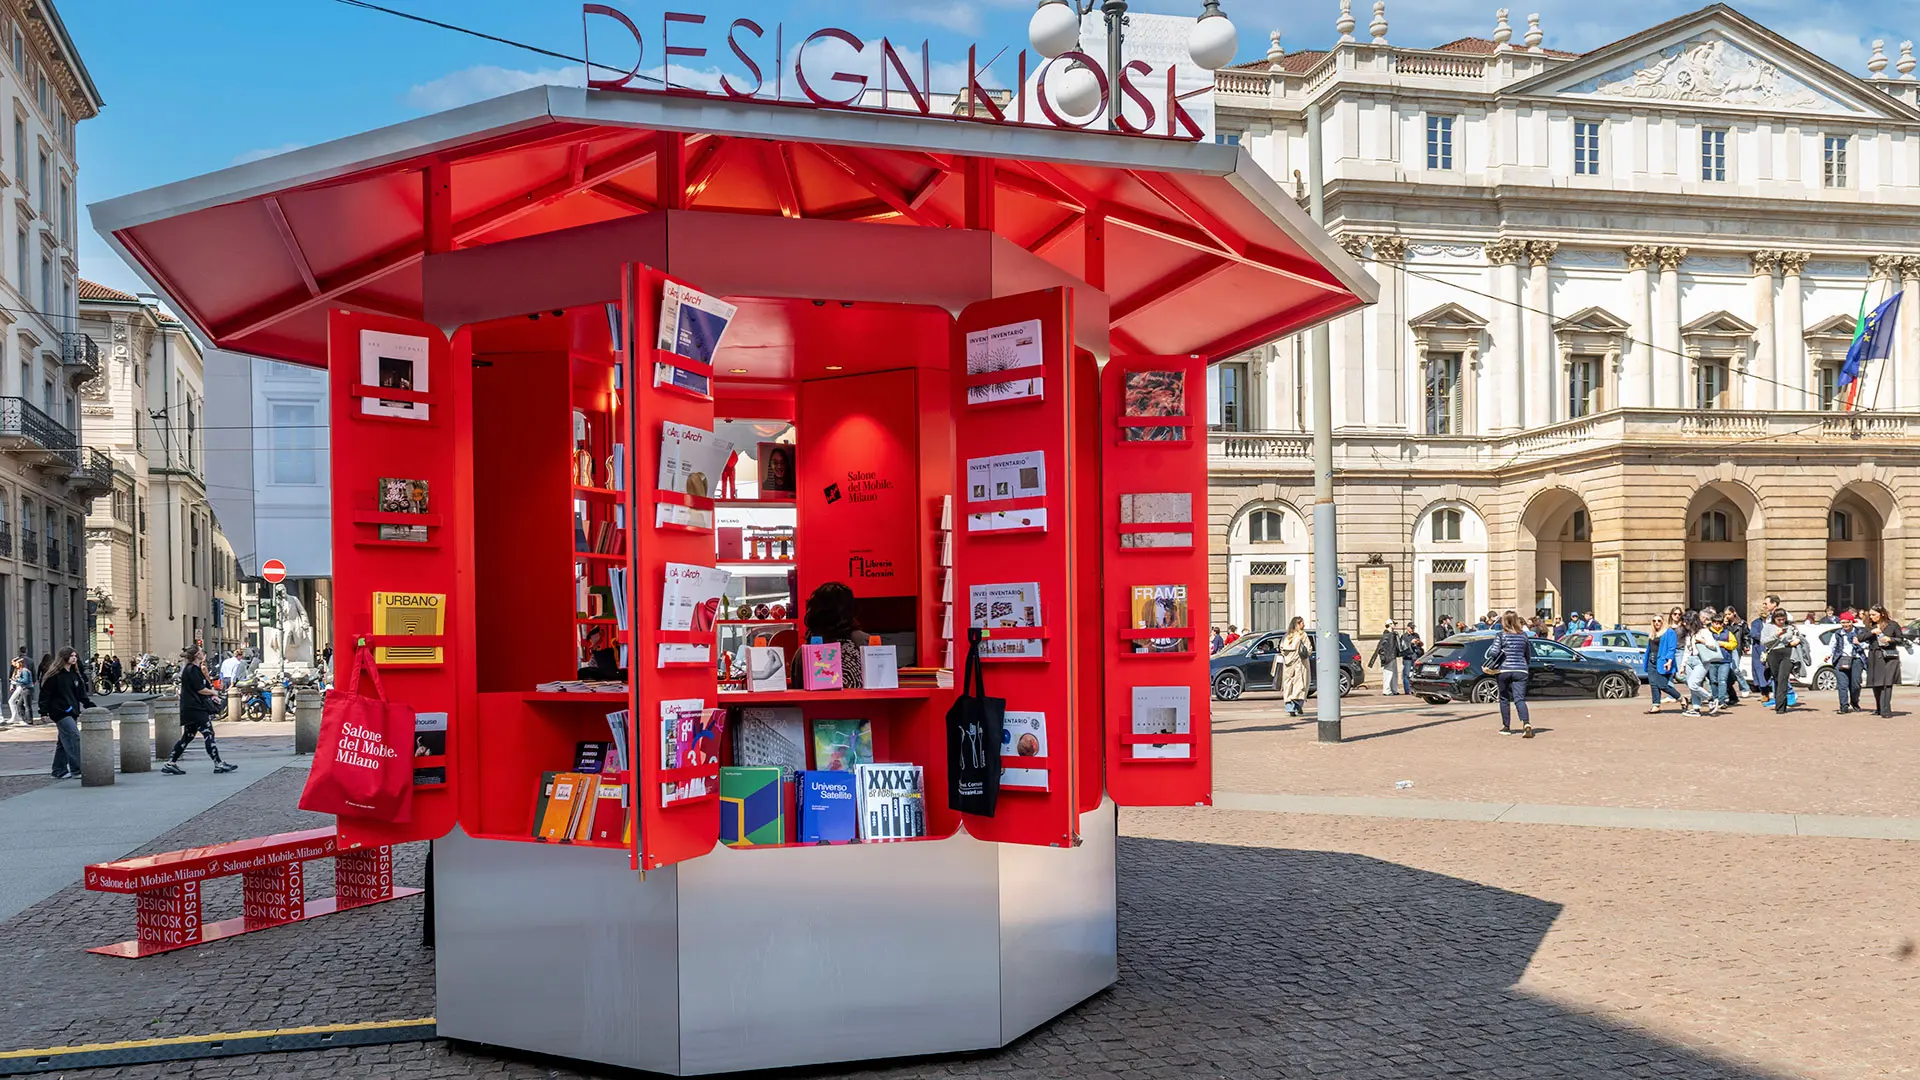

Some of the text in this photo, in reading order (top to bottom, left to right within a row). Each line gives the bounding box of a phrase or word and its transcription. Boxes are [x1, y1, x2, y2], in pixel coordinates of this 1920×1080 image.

[583, 4, 1214, 141] DESIGN KIOSK
[991, 328, 1023, 340] INVENTARIO
[993, 459, 1026, 468] INVENTARIO
[848, 470, 876, 482] Salone
[848, 480, 894, 492] del Mobile.
[848, 493, 878, 503] Milano
[865, 559, 892, 568] Librerie
[386, 595, 438, 606] URBANO
[744, 719, 788, 728] VENTURA
[341, 722, 382, 743] Salone
[339, 736, 359, 752] del
[335, 749, 379, 769] Milano
[811, 782, 848, 791] Universo
[868, 770, 920, 790] XXX-Y
[820, 791, 852, 800] Satellite
[223, 859, 252, 872] Salone
[253, 855, 266, 867] del
[336, 859, 371, 872] DESIGN
[379, 845, 390, 897] DESIGN
[99, 875, 124, 889] Salone
[124, 877, 138, 890] del
[243, 876, 280, 891] DESIGN
[348, 873, 378, 886] KIOSK
[256, 891, 286, 905] KIOSK
[289, 862, 301, 920] KIOSK D
[137, 897, 174, 912] DESIGN
[184, 881, 197, 941] DESIGN
[150, 914, 182, 929] KIOSK
